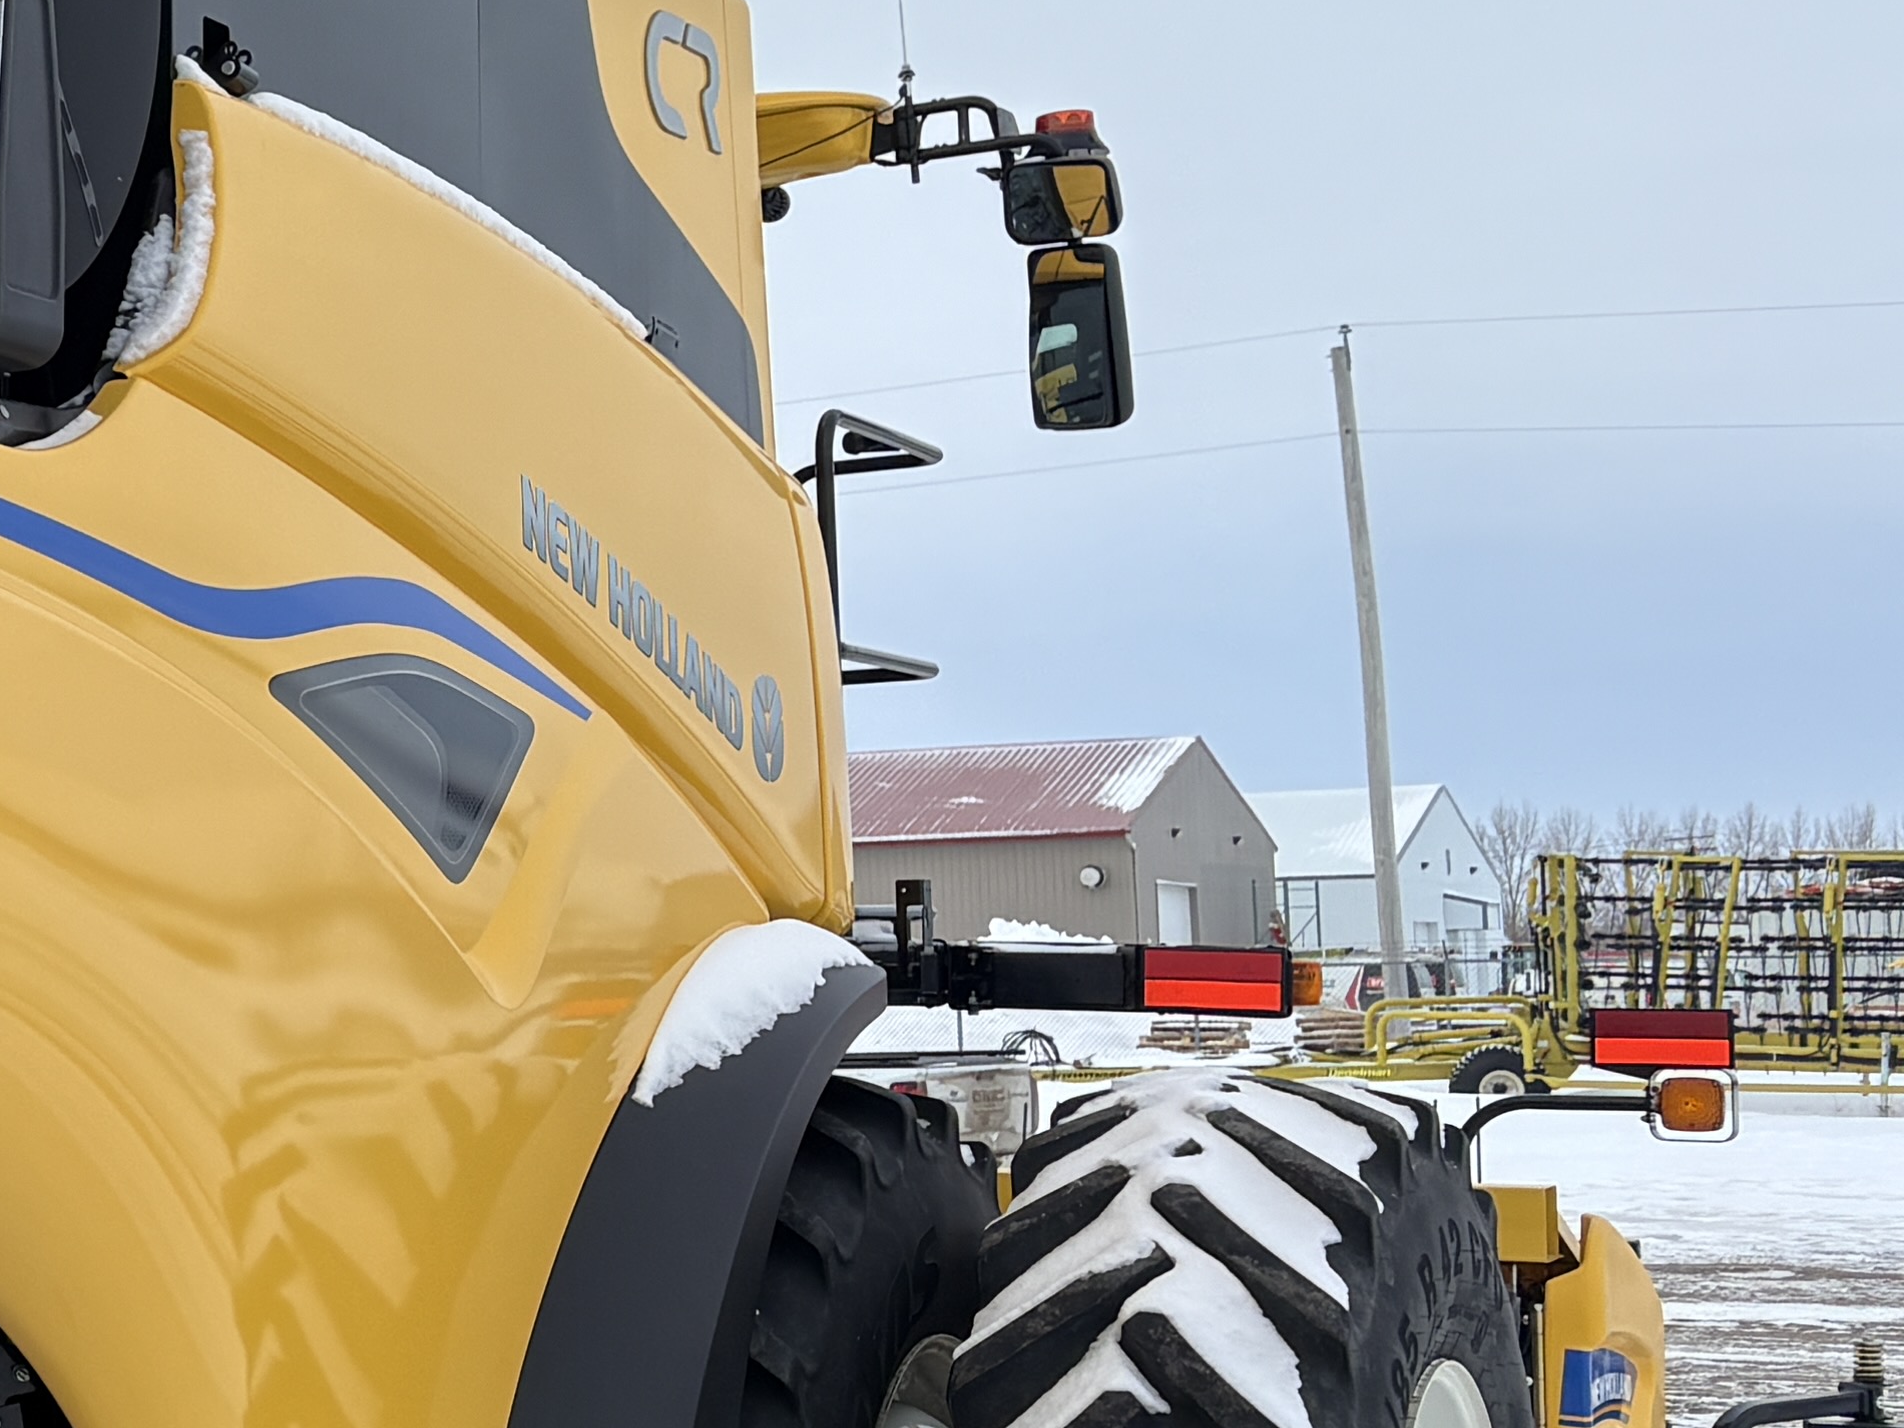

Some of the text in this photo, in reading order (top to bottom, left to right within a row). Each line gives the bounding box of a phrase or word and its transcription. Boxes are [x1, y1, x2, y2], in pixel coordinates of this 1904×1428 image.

[643, 8, 724, 156] CR
[520, 472, 743, 751] NEW HOLLAND
